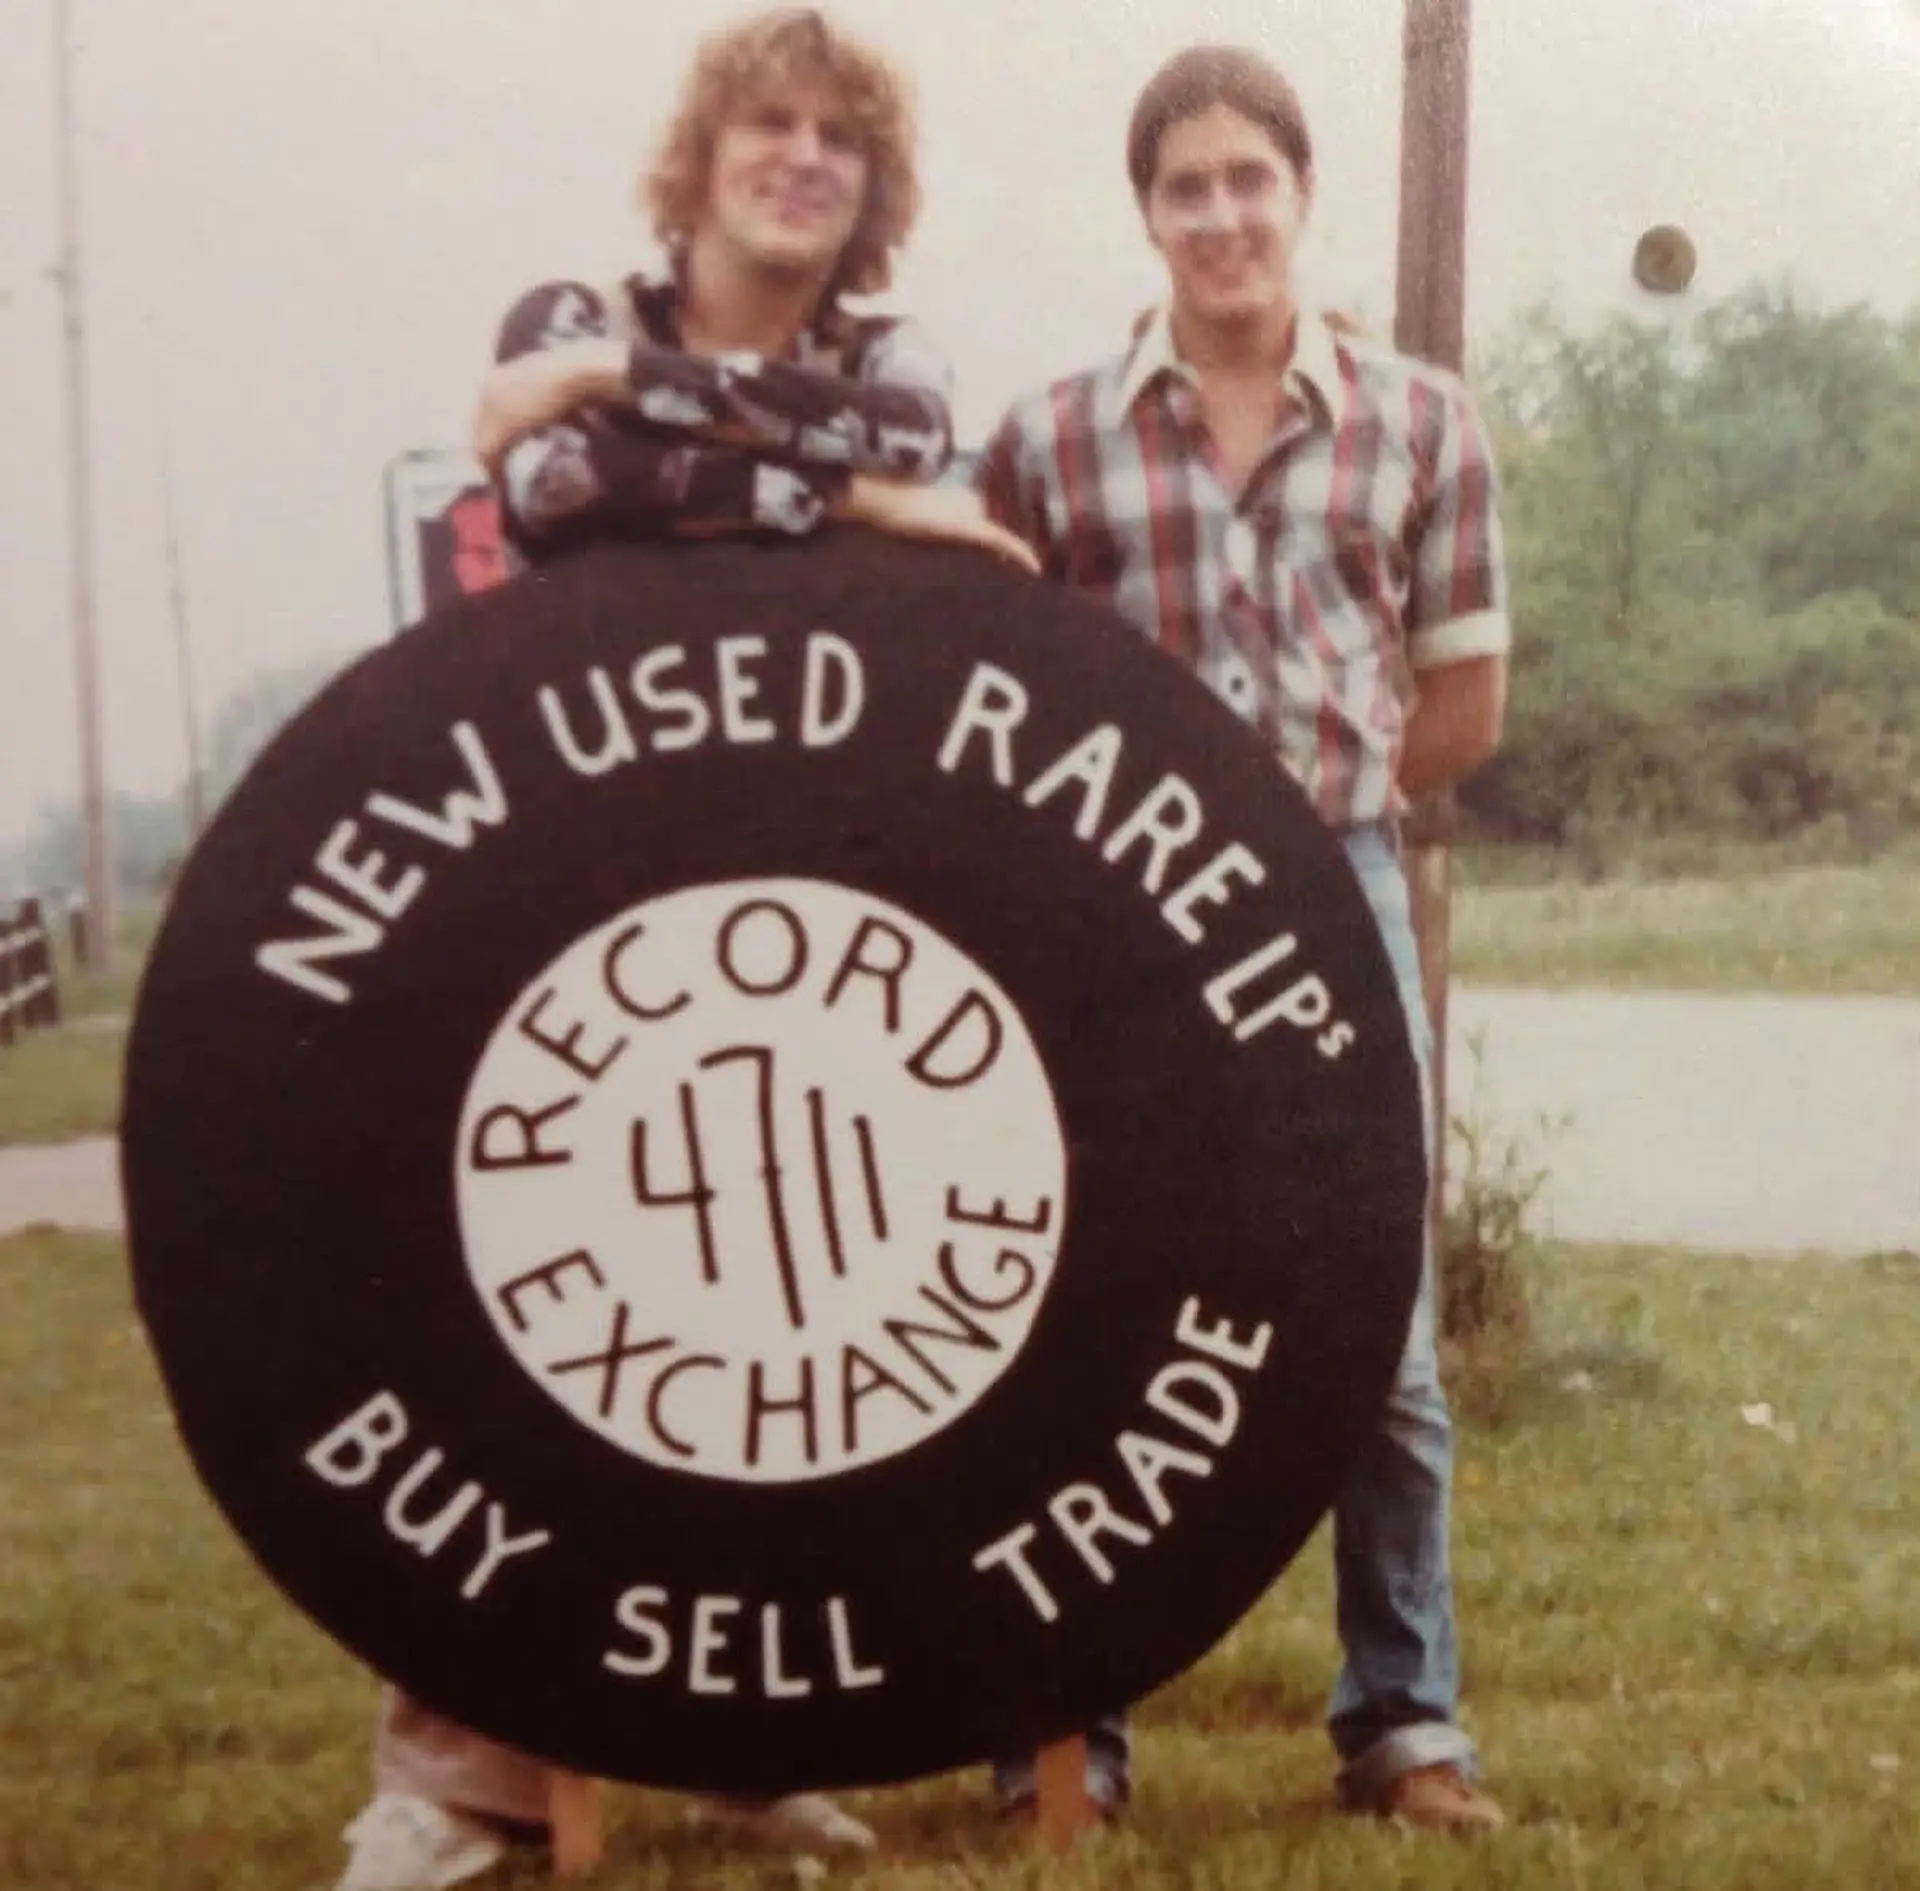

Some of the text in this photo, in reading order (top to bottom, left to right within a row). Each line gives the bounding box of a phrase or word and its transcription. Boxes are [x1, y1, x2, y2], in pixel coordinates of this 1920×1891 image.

[258, 722, 507, 1001] NEW
[539, 633, 864, 775] USED
[939, 663, 1265, 943] RARE
[470, 899, 1003, 1172] RECORD
[497, 1185, 1052, 1468] EXCHANGE
[631, 1045, 888, 1330] 4711
[306, 1297, 1272, 1696] BUY SELL TRADE
